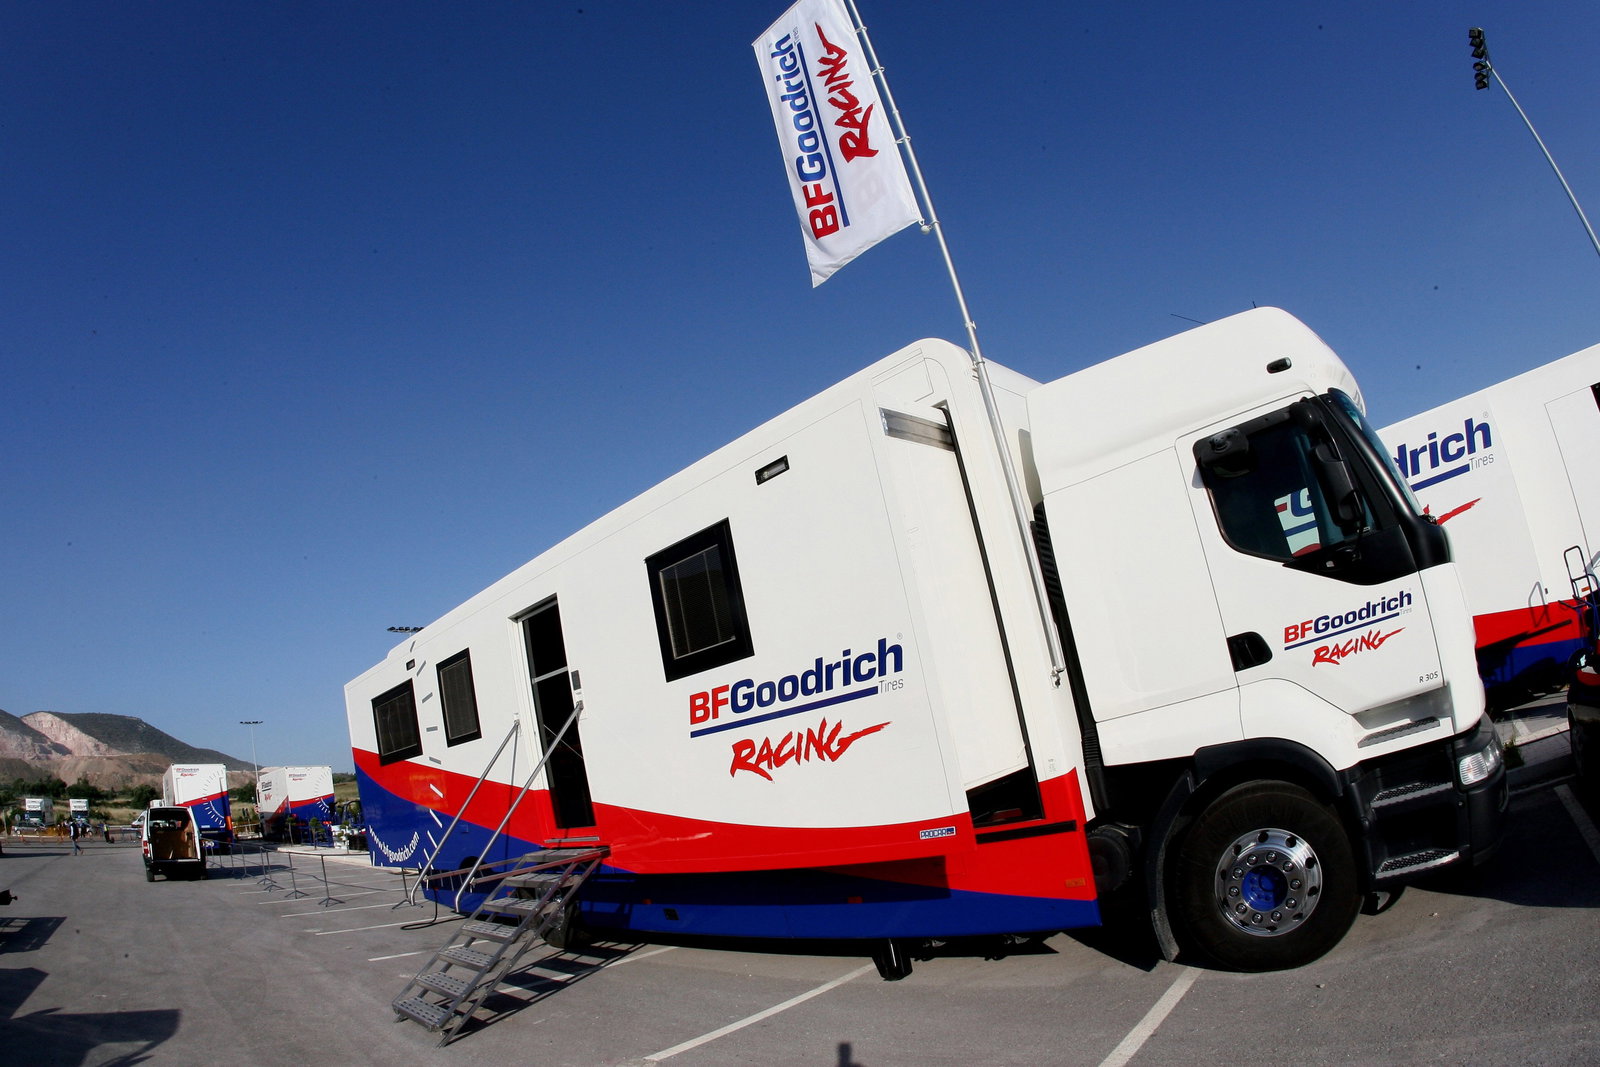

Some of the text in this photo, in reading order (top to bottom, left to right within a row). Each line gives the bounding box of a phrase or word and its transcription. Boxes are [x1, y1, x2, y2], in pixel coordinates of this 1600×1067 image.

[814, 21, 879, 163] RACING
[771, 33, 840, 240] BFGoodrich
[1469, 453, 1495, 471] Tires
[1284, 590, 1412, 644] BFGoodrich
[1311, 627, 1406, 668] RACING
[689, 637, 903, 725] BFGoodrich
[879, 678, 904, 694] Tires
[1419, 671, 1439, 683] R 305
[730, 716, 893, 782] RACING
